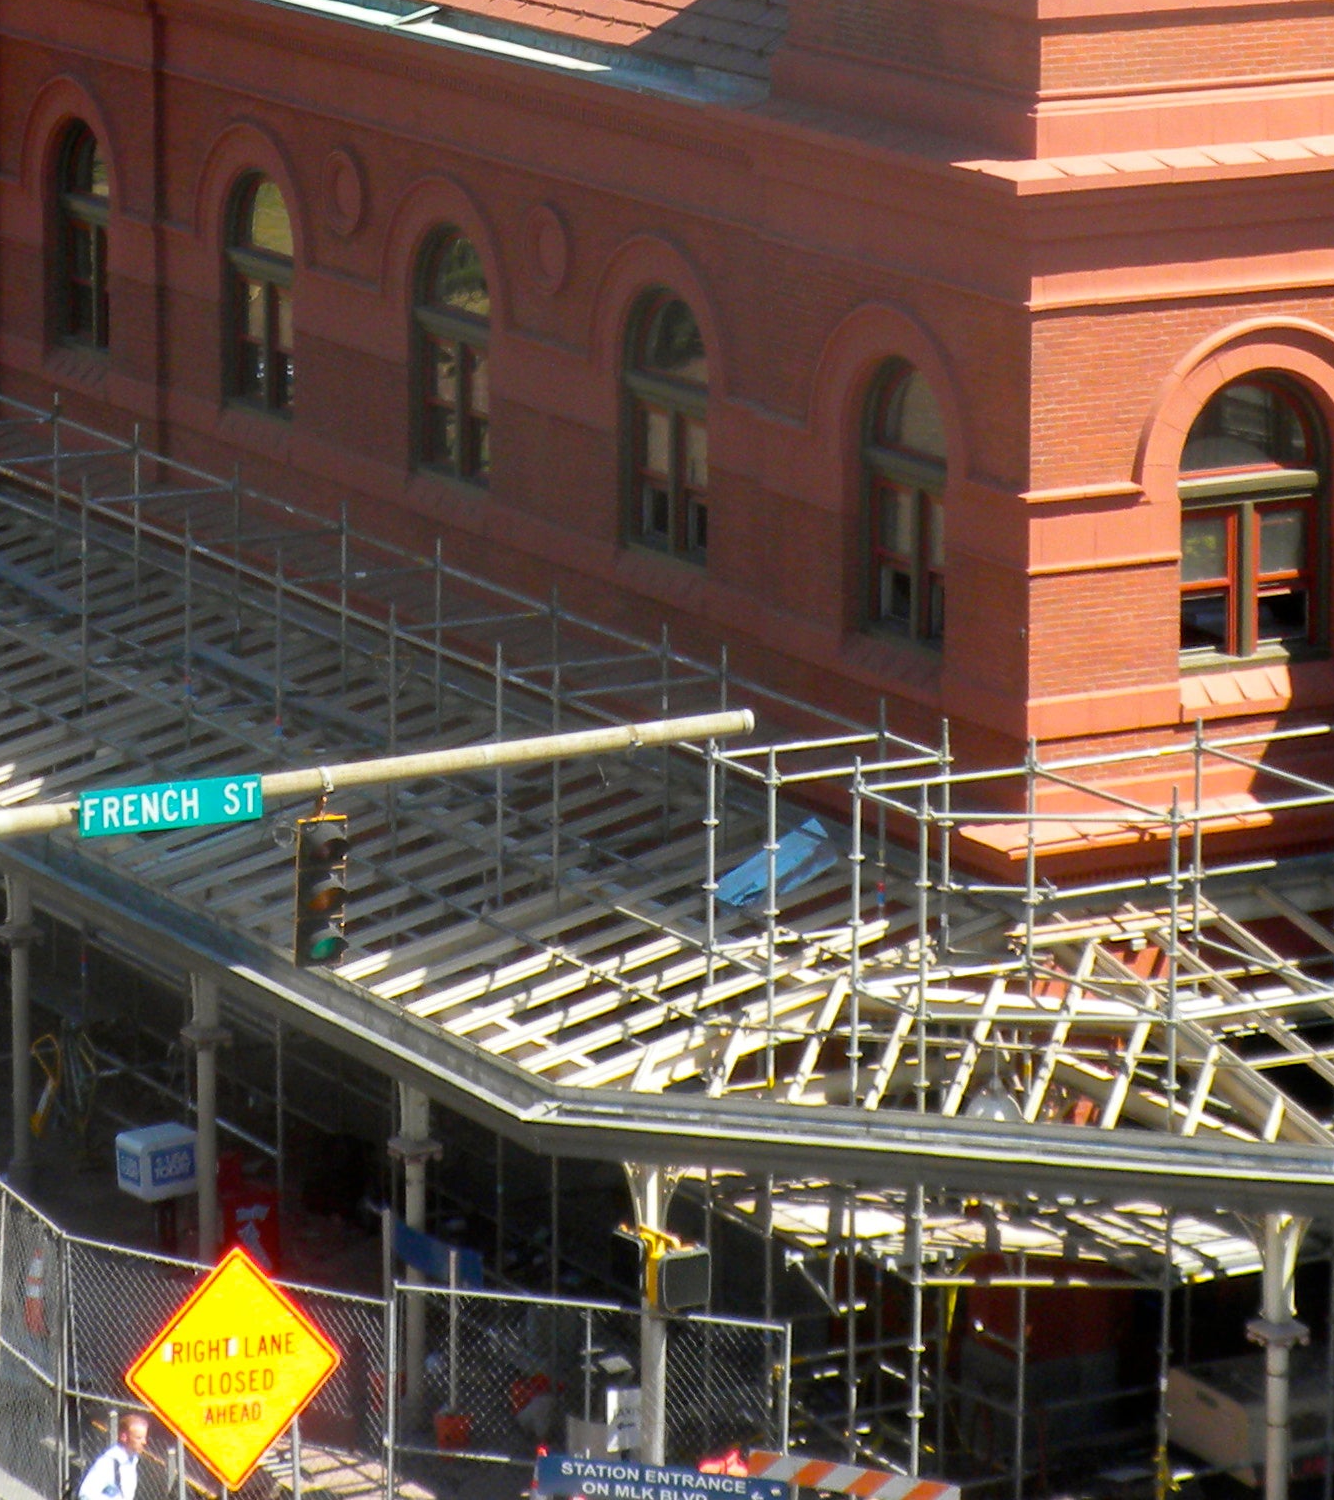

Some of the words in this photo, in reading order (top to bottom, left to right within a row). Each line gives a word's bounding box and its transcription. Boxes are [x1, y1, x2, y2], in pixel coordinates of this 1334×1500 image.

[82, 787, 199, 831] FRENCH
[223, 781, 259, 816] ST
[171, 1337, 234, 1366] RIGHT
[244, 1332, 295, 1359] LANE
[193, 1368, 274, 1397] CLOSED
[204, 1402, 263, 1426] AHEAD
[561, 1461, 639, 1482] STATION
[645, 1468, 747, 1495] ENTRANCE
[581, 1481, 609, 1497] ON
[614, 1484, 654, 1500] MLK
